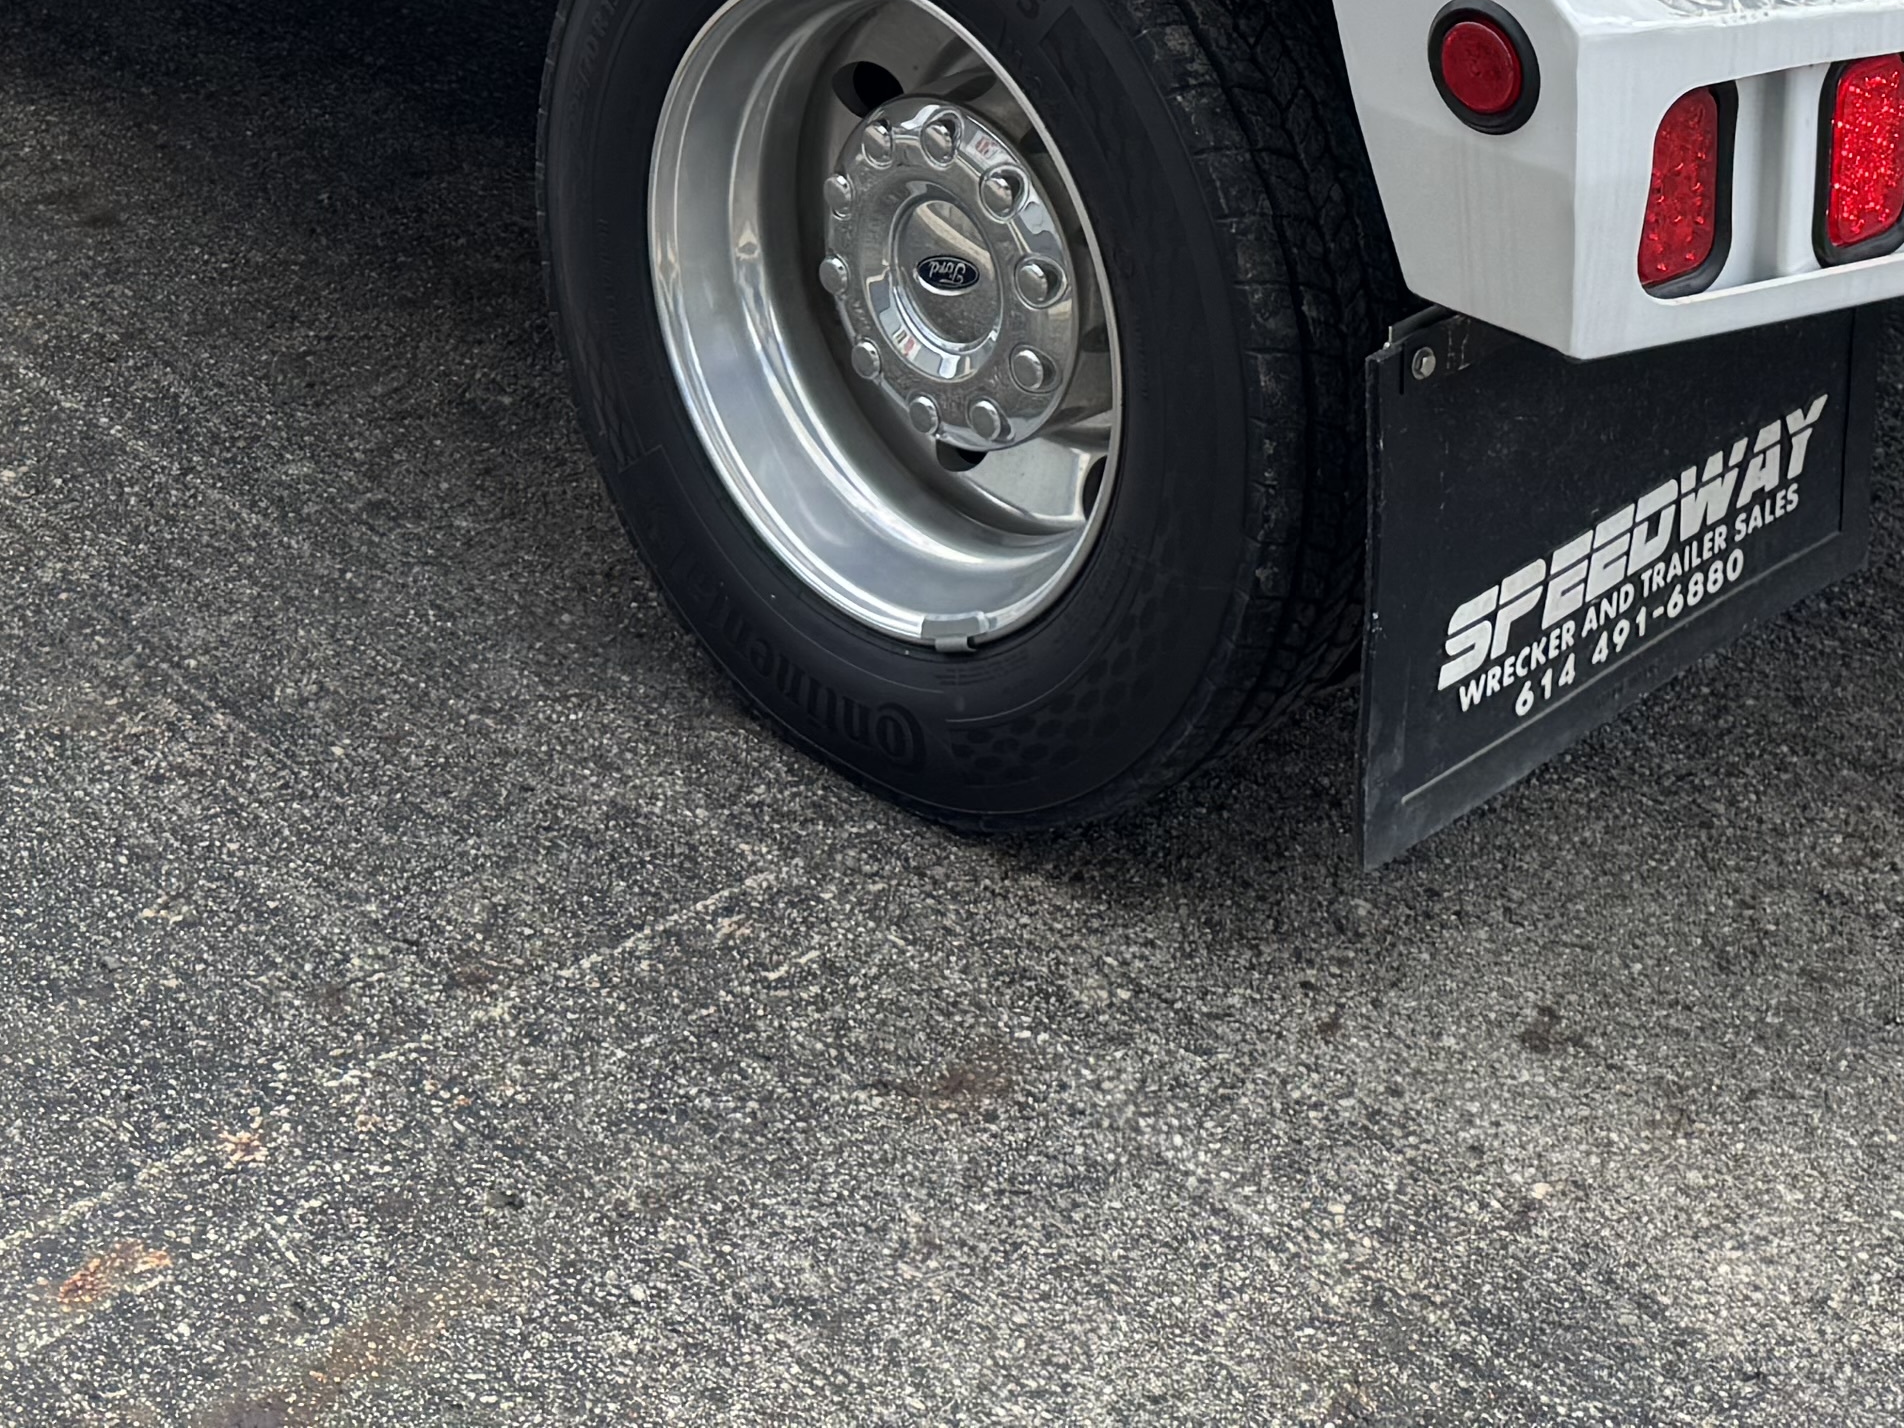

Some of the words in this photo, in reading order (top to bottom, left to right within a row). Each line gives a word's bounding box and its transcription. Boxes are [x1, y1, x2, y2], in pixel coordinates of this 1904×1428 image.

[928, 261, 967, 285] Ford
[1437, 392, 1829, 692] SPEEDWAY
[1458, 624, 1576, 712] WRECKER
[1580, 585, 1635, 639] AND
[1639, 531, 1728, 599] TRAILER
[1733, 482, 1801, 543] SALES
[1514, 659, 1577, 717] 614
[1592, 548, 1746, 667] 491-6880
